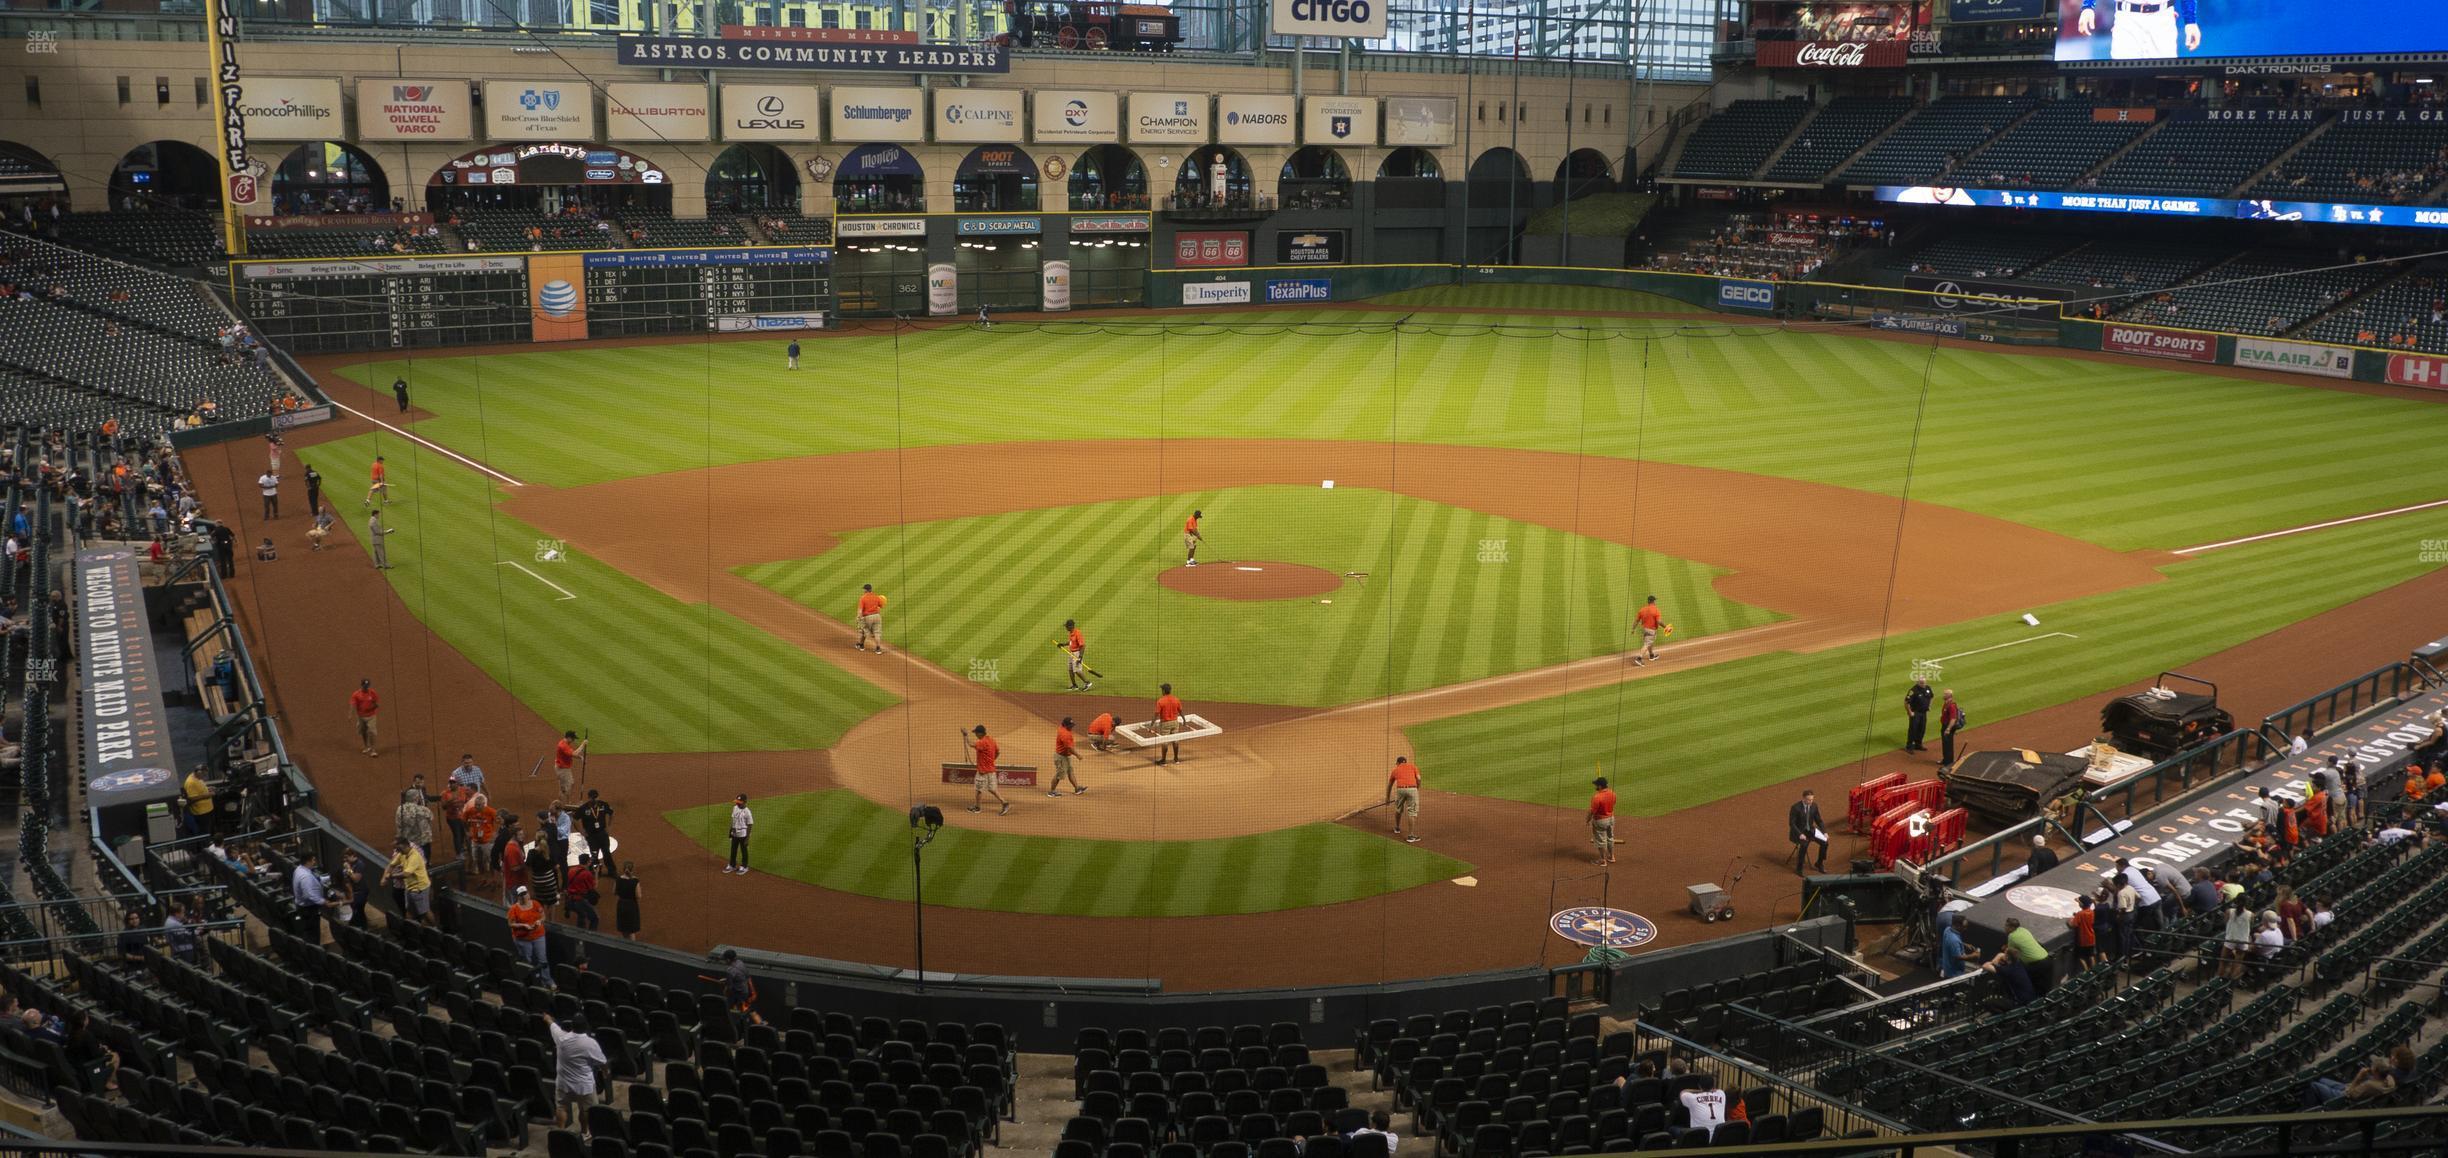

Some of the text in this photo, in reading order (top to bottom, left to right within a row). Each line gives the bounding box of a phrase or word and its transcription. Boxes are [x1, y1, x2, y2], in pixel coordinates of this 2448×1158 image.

[1292, 0, 1370, 23] CITGO
[744, 30, 899, 41] MINUTE MAID
[635, 44, 997, 67] ASTROS COMMUNITY LEADERS
[1797, 43, 1869, 66] Coca-Cola
[2225, 64, 2332, 75] DAKTRONICS
[239, 104, 331, 120] ConocoPhillips
[383, 105, 446, 114] NATIONAL
[610, 107, 705, 116] HALLIBURTON
[844, 105, 912, 123] Schlumberger
[964, 110, 1014, 120] CALPINE
[1320, 107, 1362, 115] FOUNDATION
[389, 115, 441, 123] OILWELL
[540, 115, 580, 123] BlueShield
[1241, 114, 1288, 125] NABORS
[2208, 110, 2256, 120] MORE
[2267, 110, 2314, 120] THAN
[2342, 110, 2385, 121] JUST
[2396, 110, 2406, 121] A
[737, 119, 805, 129] LEXUS
[1140, 116, 1198, 127] CHAMPION
[396, 125, 436, 134] VARCO
[515, 143, 587, 159] Landry's
[982, 151, 1014, 162] ROOT
[861, 149, 899, 169] Montejo
[2062, 196, 2096, 208] MORE
[2097, 198, 2127, 209] THAN
[2127, 199, 2151, 211] JUST
[2151, 200, 2161, 211] A
[2161, 201, 2200, 212] GAME.
[842, 222, 921, 232] HOUSTON CHRONICLE
[963, 222, 970, 231] C
[979, 222, 986, 231] D
[988, 222, 1012, 231] SCRAP
[1013, 221, 1036, 230] METAL
[1770, 233, 1815, 245] Budweiser
[1182, 248, 1194, 256] 66
[1204, 248, 1217, 256] 66
[1228, 247, 1240, 255] 66
[898, 284, 917, 292] 362
[1200, 286, 1248, 300] Insperity
[1268, 284, 1328, 299] TexanPlus
[1721, 285, 1772, 303] GEICO
[1901, 319, 1957, 334] PLATINUM POOLS
[1979, 334, 1994, 342] 373
[2111, 328, 2152, 345] ROOT
[2154, 336, 2206, 352] SPORTS
[2240, 348, 2276, 362] EVA
[2277, 352, 2312, 366] AIR
[85, 566, 133, 763] WELCOME TO MINUTE MAID PARK
[1558, 909, 1611, 929] HOUSTON
[1707, 1103, 1717, 1120] 1
